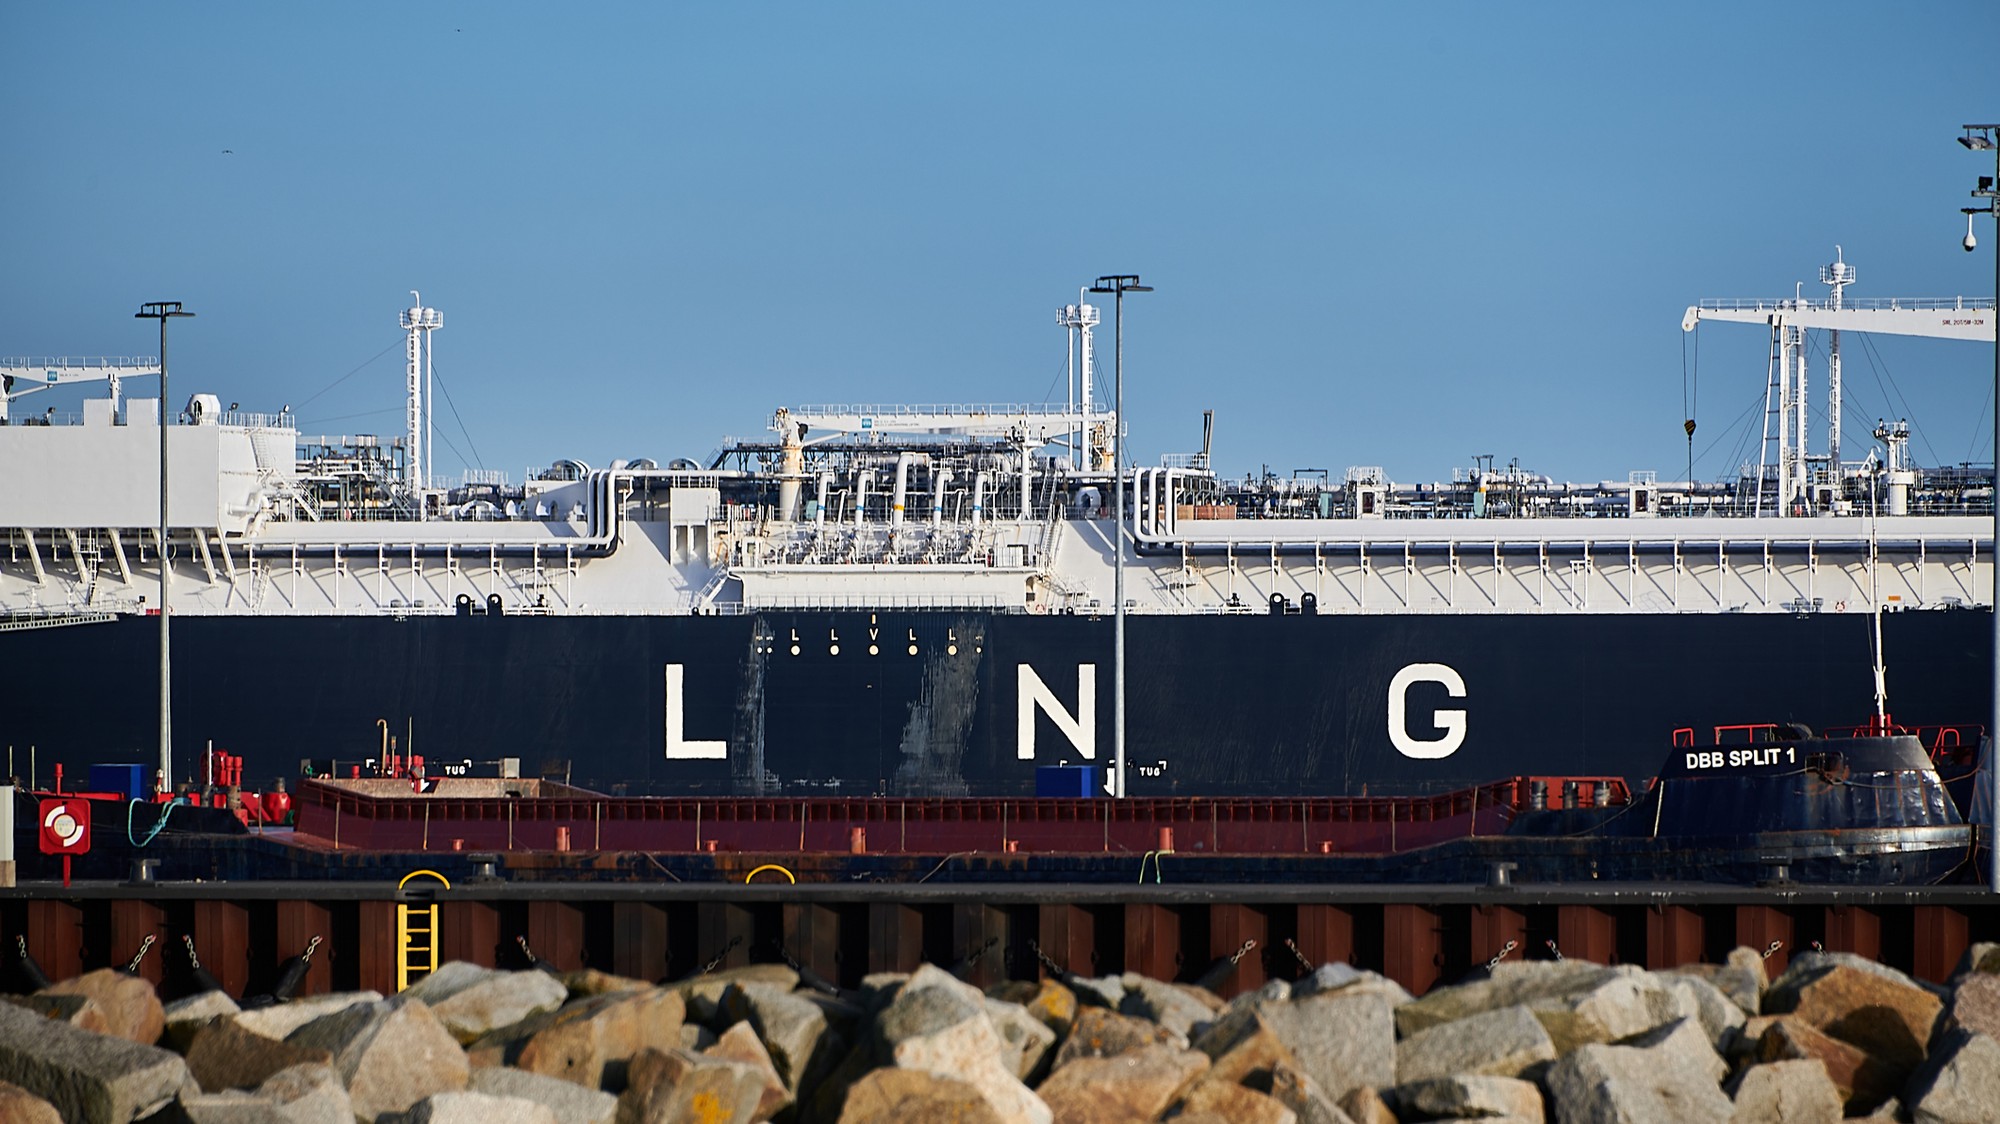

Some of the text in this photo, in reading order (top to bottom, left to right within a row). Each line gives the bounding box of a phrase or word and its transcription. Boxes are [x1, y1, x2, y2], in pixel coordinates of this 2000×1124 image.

[791, 628, 957, 641] L L V L L
[665, 663, 1467, 759] L N G
[1686, 747, 1795, 769] DBB SPLIT 1
[445, 765, 466, 775] TUG
[1139, 767, 1160, 777] TUG
